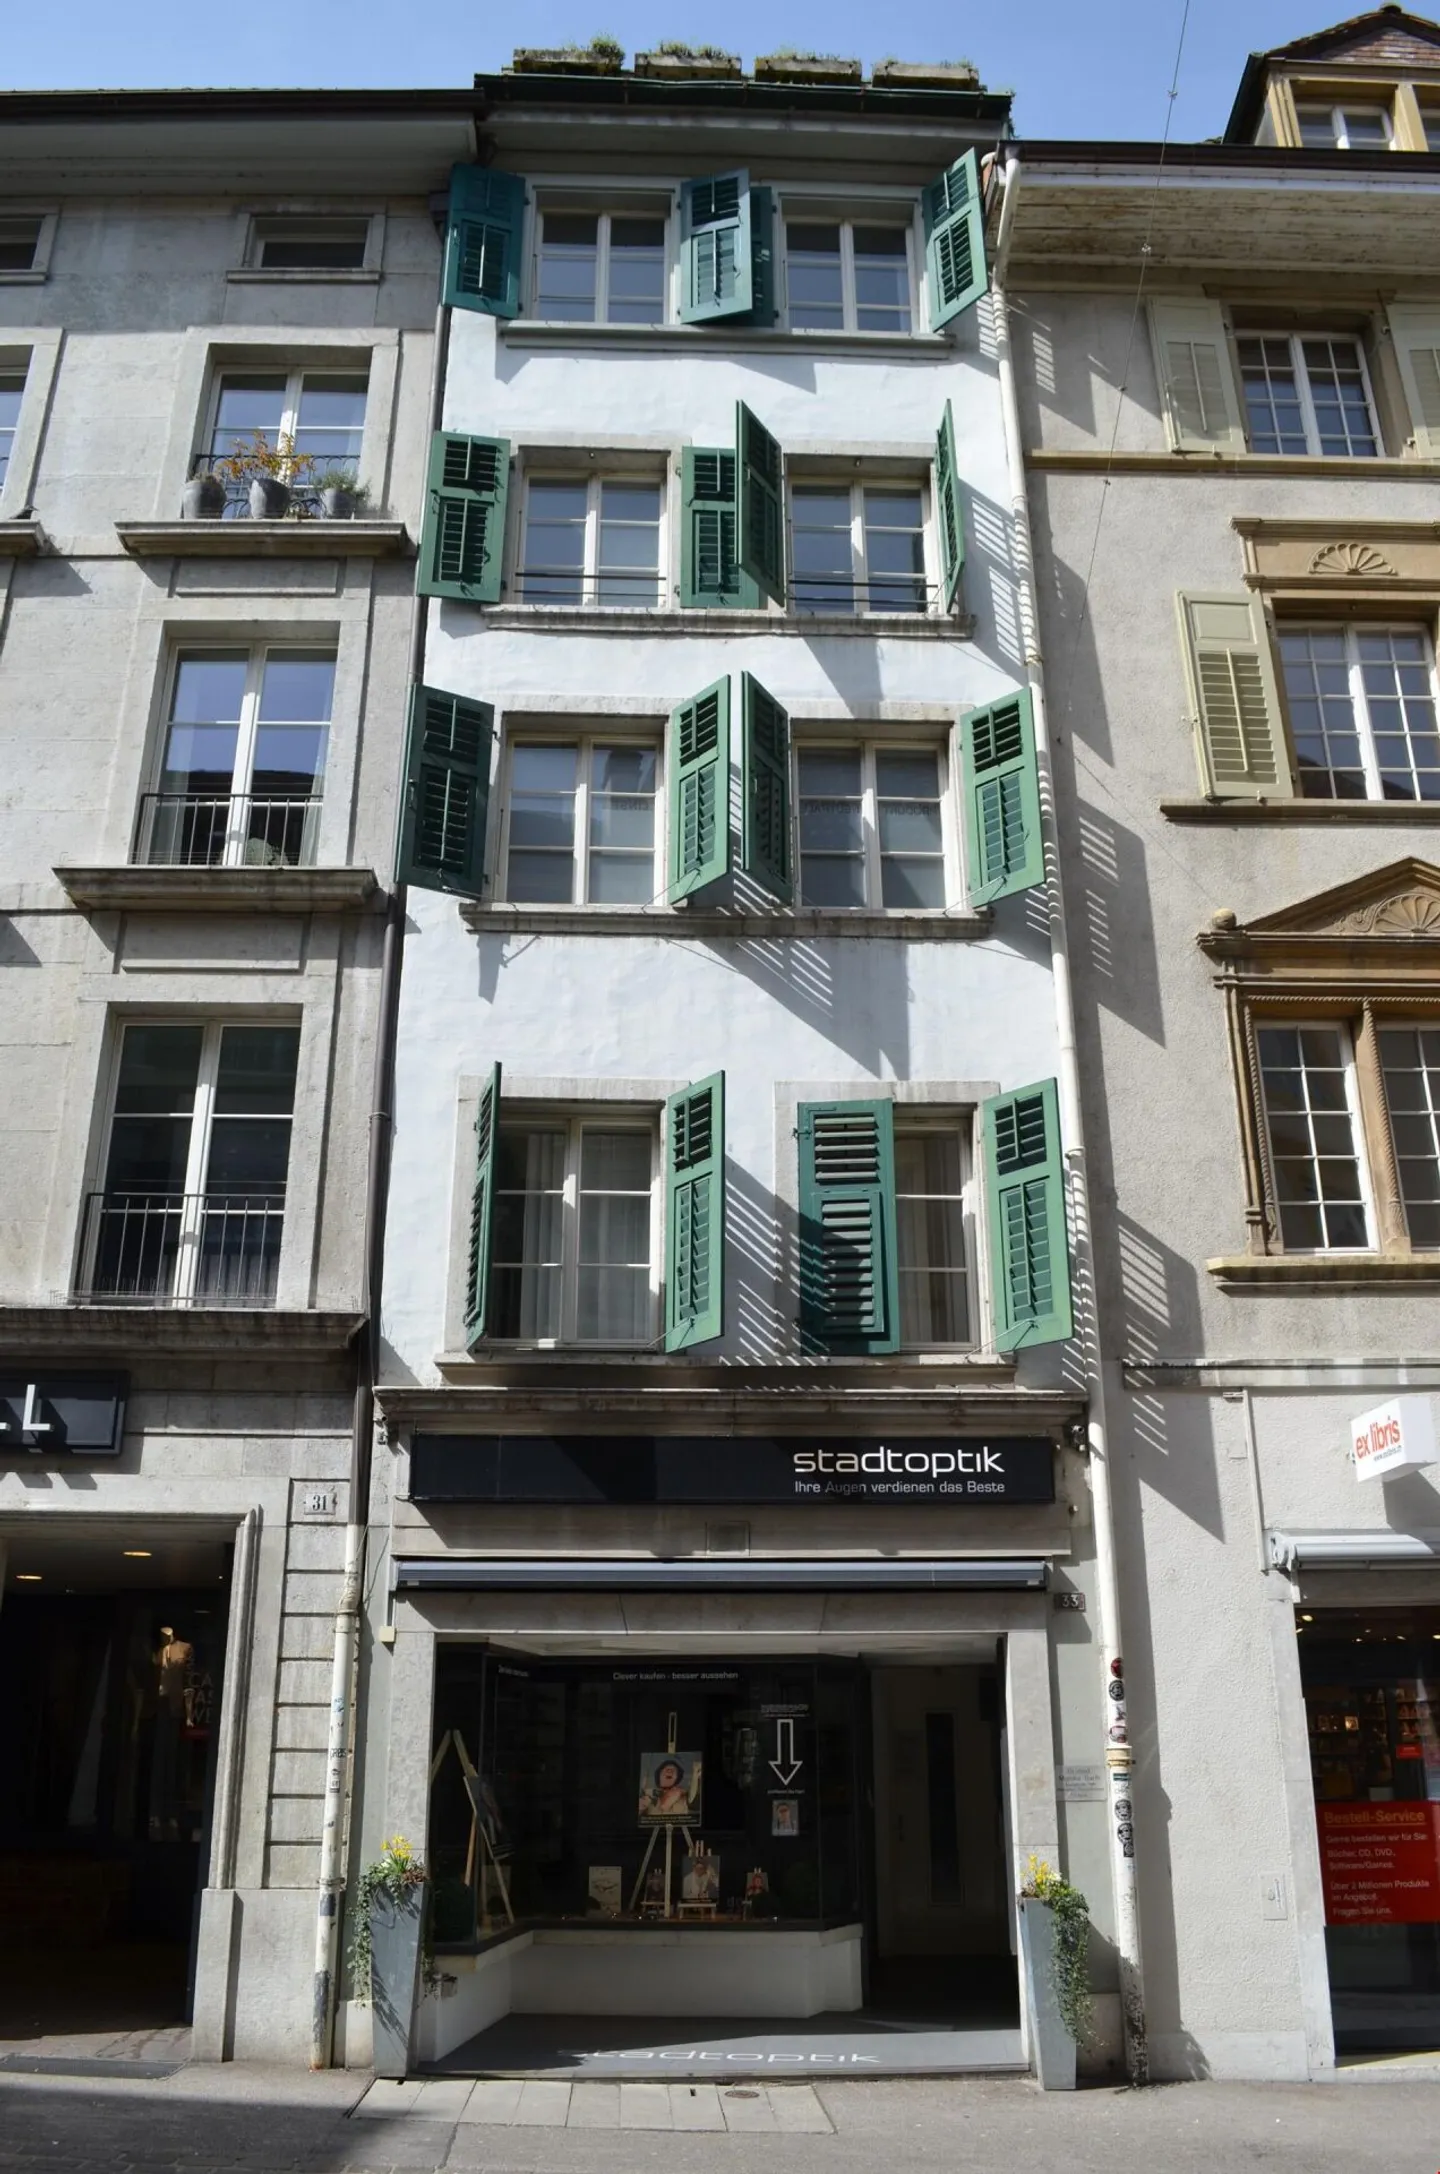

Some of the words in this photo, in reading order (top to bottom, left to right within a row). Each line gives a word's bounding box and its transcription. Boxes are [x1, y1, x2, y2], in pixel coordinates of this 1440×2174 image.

[1357, 1432, 1375, 1459] ex
[1372, 1421, 1401, 1453] libris
[793, 1446, 1005, 1478] stadtoptik
[795, 1481, 821, 1492] Ihre
[825, 1481, 867, 1495] Augen
[871, 1481, 934, 1493] verdienen
[939, 1481, 963, 1493] das
[967, 1481, 1005, 1493] Beste
[312, 1494, 328, 1511] 31
[1061, 1593, 1079, 1607] 33
[1324, 1809, 1426, 1824] Bestell-Service
